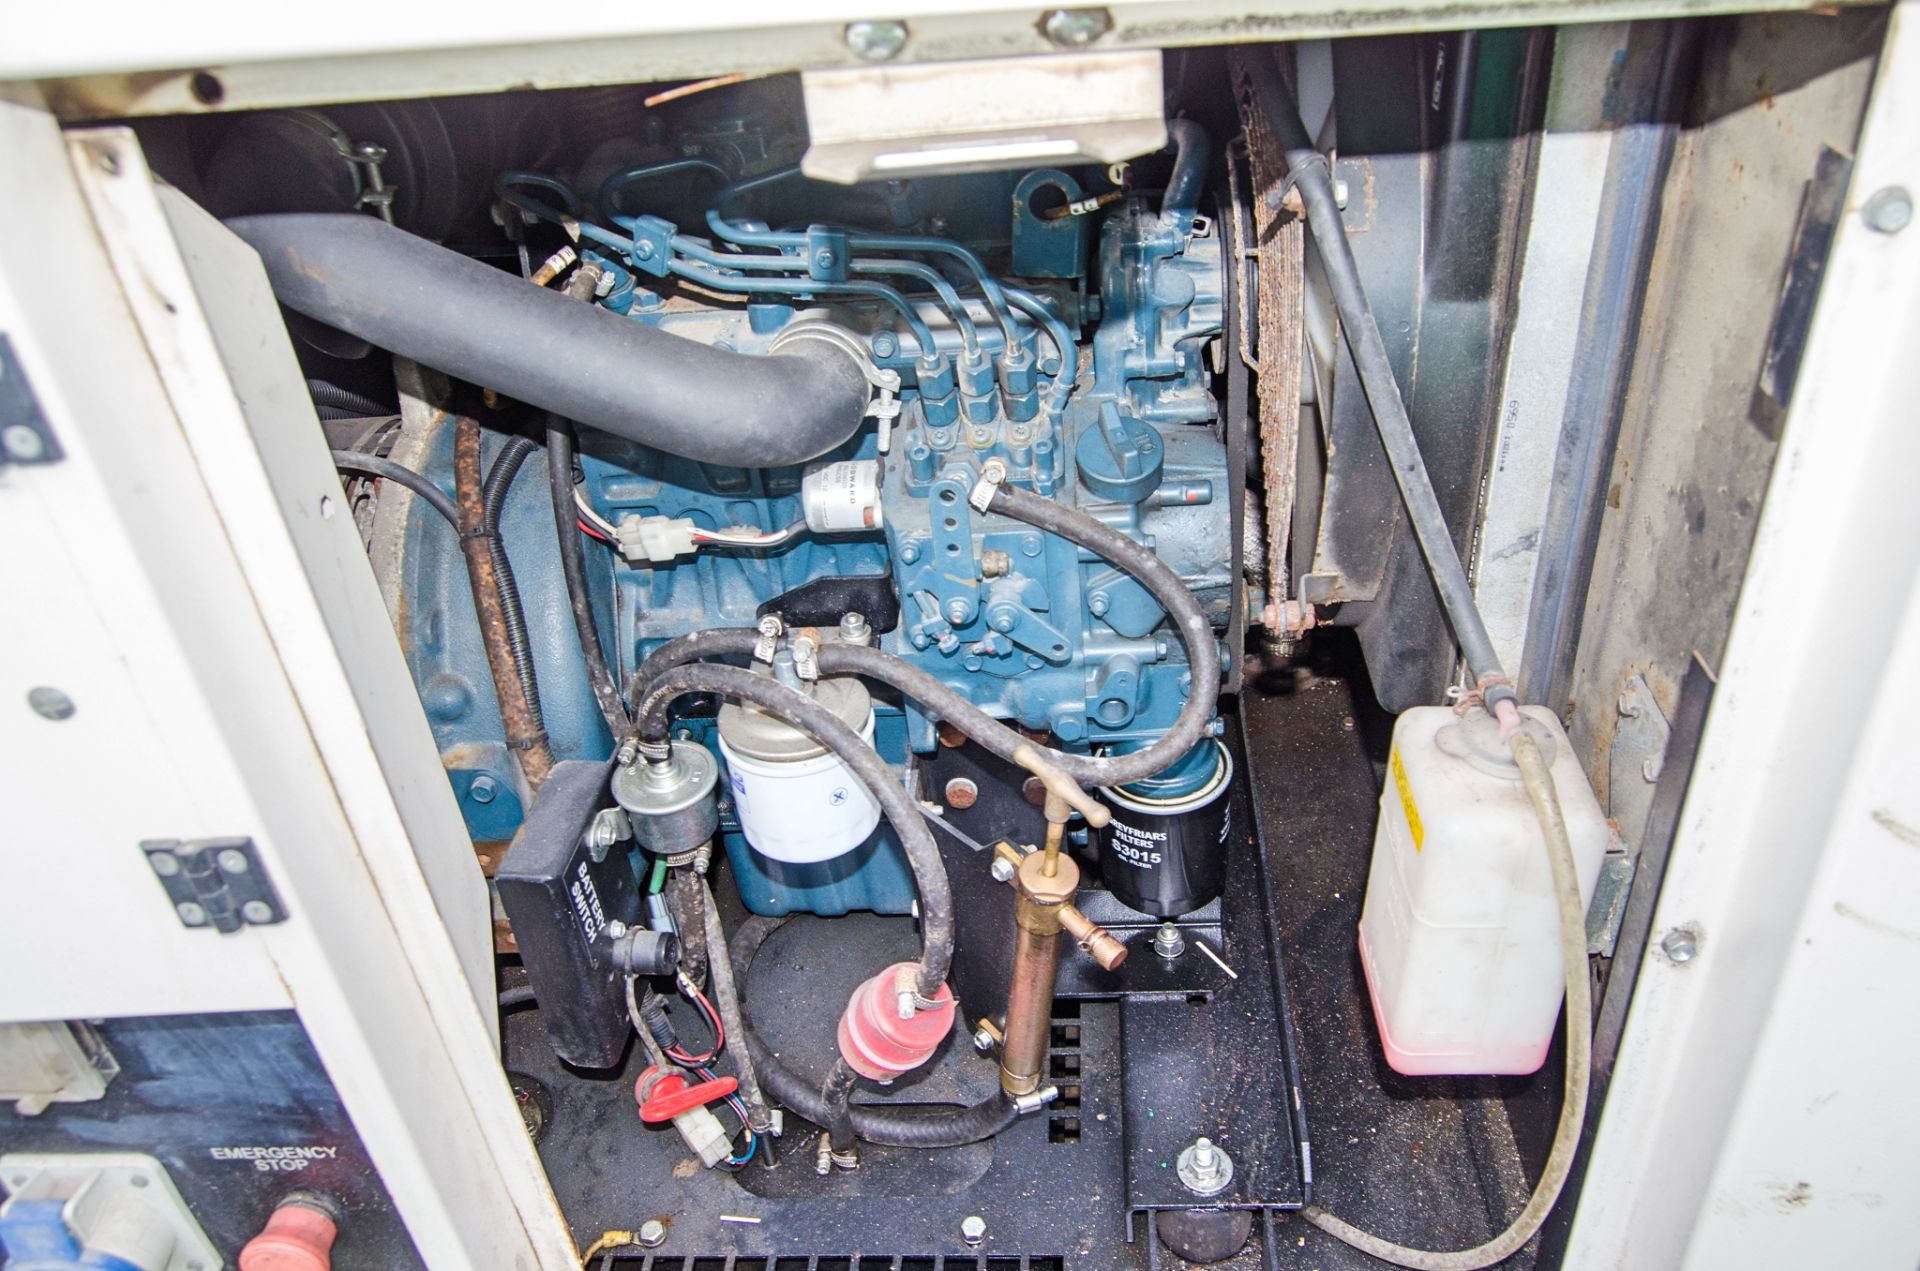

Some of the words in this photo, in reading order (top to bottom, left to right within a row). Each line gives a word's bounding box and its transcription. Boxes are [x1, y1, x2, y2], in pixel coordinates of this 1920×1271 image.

[1115, 829, 1154, 849] FILTERS
[1111, 838, 1162, 864] S3015
[1129, 859, 1153, 870] FILTER
[578, 861, 606, 931] BATTERY
[571, 881, 597, 944] SWITCH
[210, 1146, 337, 1160] EMERGENCY
[254, 1159, 309, 1172] STOP
